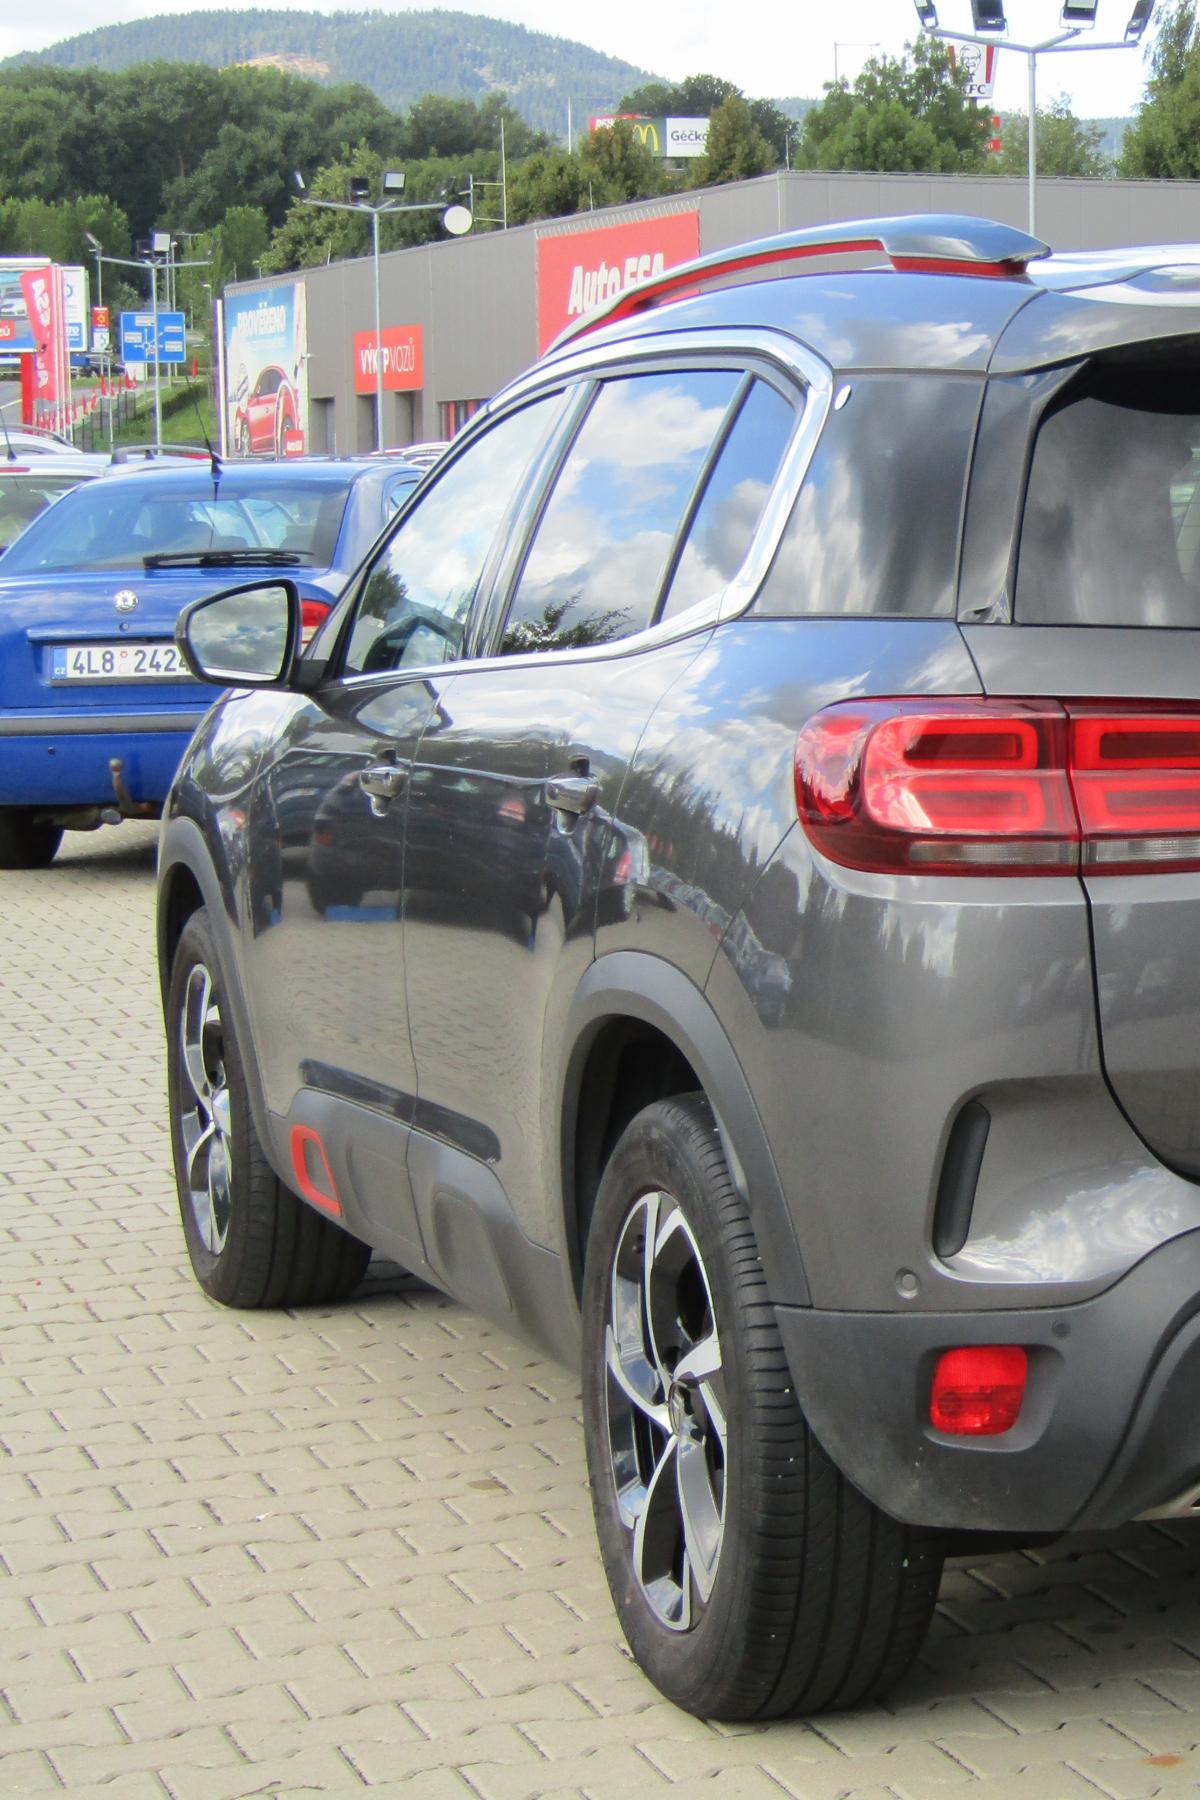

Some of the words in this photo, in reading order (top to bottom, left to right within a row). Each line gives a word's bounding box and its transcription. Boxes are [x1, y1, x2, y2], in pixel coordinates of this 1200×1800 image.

[567, 261, 621, 315] Auto
[360, 342, 389, 375] VÝKP
[389, 336, 415, 373] VOZŮ
[72, 650, 115, 674] 4L8
